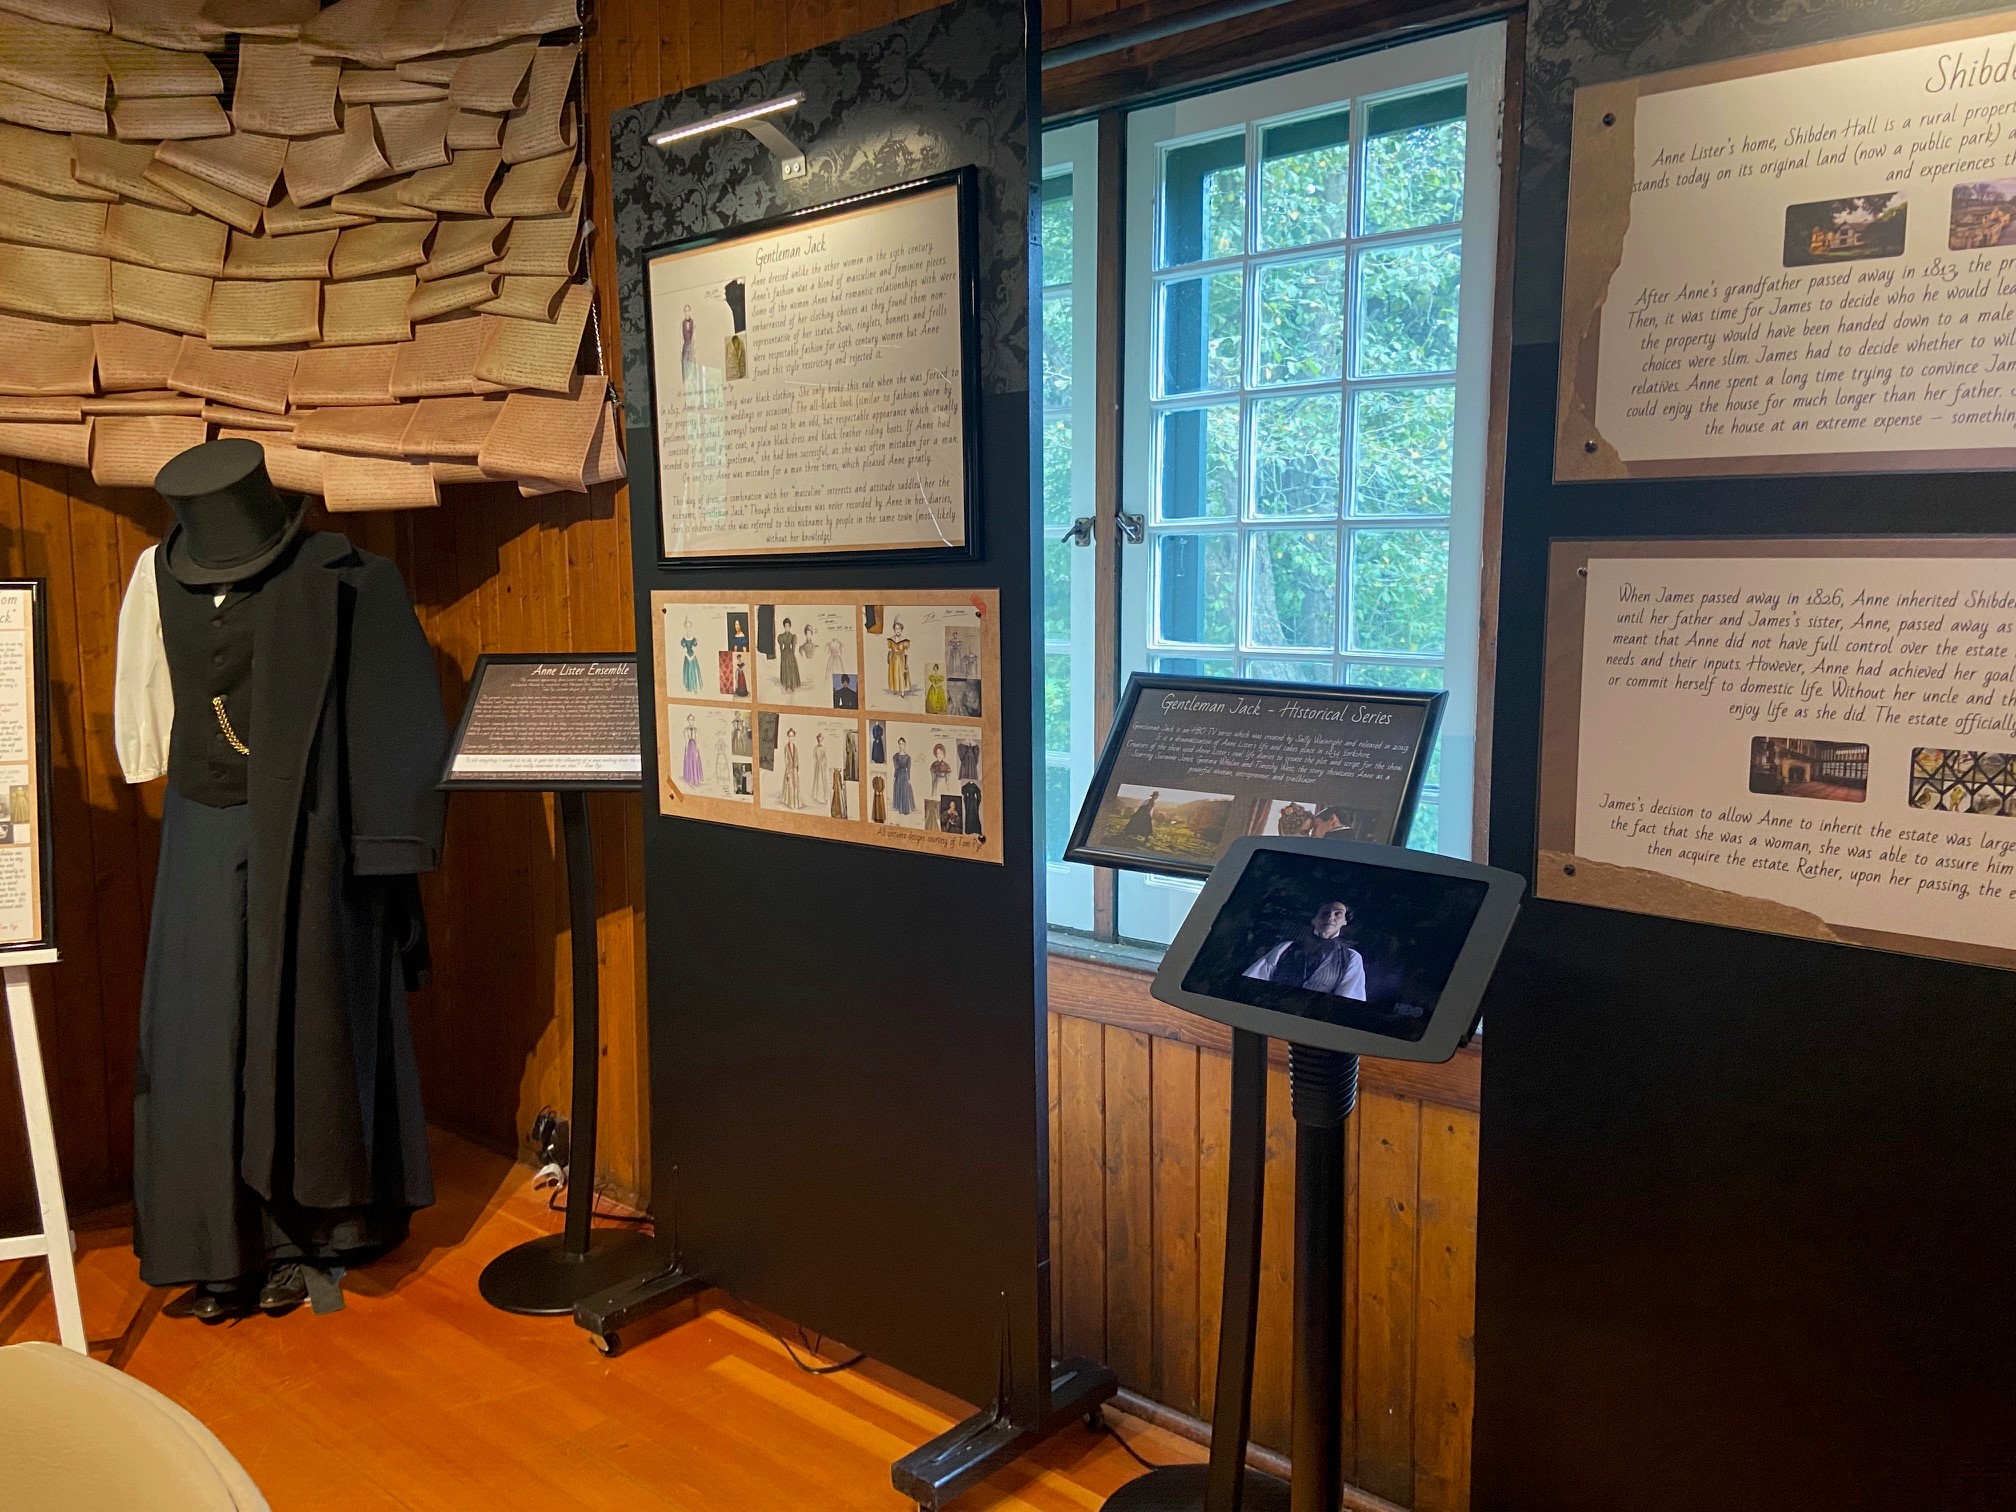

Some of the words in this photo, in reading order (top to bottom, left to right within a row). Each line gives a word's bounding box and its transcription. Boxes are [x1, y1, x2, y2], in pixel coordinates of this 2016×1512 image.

[1651, 148, 1685, 167] Anne
[1690, 137, 1735, 161] Lister's
[1741, 134, 1777, 154] home,
[1784, 123, 1837, 147] Shibden
[1841, 114, 1878, 138] Hall
[1884, 118, 1895, 132] is
[1902, 118, 1911, 129] a
[1919, 102, 1958, 127] rural
[1632, 167, 1671, 195] stands
[1676, 166, 1711, 190] today
[1716, 169, 1731, 181] on
[1738, 164, 1753, 177] its
[1760, 149, 1811, 179] original
[1816, 144, 1848, 166] land
[1854, 141, 1887, 166] (now
[1893, 144, 1903, 155] a
[1908, 130, 1953, 161] public
[1958, 122, 2001, 154] park)
[1885, 159, 1915, 181] and
[1920, 157, 1996, 183] experiences
[751, 275, 765, 287] Anne
[769, 267, 789, 284] dressed
[792, 266, 808, 278] unlike
[812, 262, 821, 275] the
[824, 260, 839, 272] other
[843, 257, 863, 267] women
[877, 248, 886, 260] the
[755, 243, 800, 272] Gentleman
[804, 233, 826, 255] Jack
[752, 287, 770, 301] Anne's
[771, 285, 793, 302] fashion
[797, 284, 807, 292] was
[818, 275, 833, 288] blend
[837, 274, 844, 289] of
[846, 268, 876, 283] masculine
[880, 262, 891, 276] and
[892, 262, 923, 278] feminine
[1634, 288, 1671, 314] After
[1674, 280, 1718, 302] Anne's
[1723, 273, 1802, 303] grandfather
[1807, 266, 1853, 295] passed
[1858, 269, 1895, 288] away
[1902, 265, 1915, 279] in
[1921, 257, 1959, 282] 1813,
[1968, 253, 1992, 273] the
[1705, 418, 1724, 435] the
[1730, 416, 1765, 434] house
[1770, 419, 1786, 432] at
[1791, 420, 1809, 431] an
[1816, 417, 1867, 430] extreme
[1873, 415, 1923, 434] expense
[766, 532, 787, 542] without
[790, 531, 798, 541] her
[1619, 582, 1651, 603] When
[1655, 586, 1695, 603] James
[1700, 587, 1742, 612] passed
[1746, 592, 1781, 611] away
[1787, 592, 1800, 605] in
[1805, 588, 1844, 609] 1826,
[1850, 588, 1890, 607] Anne
[1896, 589, 1960, 608] inherited
[1617, 608, 1645, 624] until
[1650, 608, 1670, 624] her
[1668, 604, 1714, 631] father
[1719, 609, 1745, 626] and
[1748, 610, 1800, 628] James's
[1807, 616, 1844, 631] sister,
[1849, 611, 1891, 633] Anne,
[1896, 614, 1945, 637] passed
[1950, 619, 1989, 640] away
[1996, 623, 2014, 633] as
[531, 664, 557, 676] Anne
[559, 664, 585, 676] Lister
[588, 663, 630, 675] Ensemble
[1606, 650, 1635, 666] needs
[1640, 651, 1665, 667] and
[1669, 651, 1698, 668] their
[1703, 657, 1741, 675] inputs.
[1746, 654, 1805, 676] However,
[1811, 656, 1850, 675] Anne
[1856, 658, 1884, 676] had
[1889, 660, 1948, 679] achieved
[1953, 662, 1978, 680] her
[1982, 664, 2016, 688] goal
[1162, 693, 1225, 715] Gentleman
[1230, 698, 1260, 715] Jack
[1279, 701, 1348, 722] Historical
[1352, 706, 1392, 724] Series
[1599, 793, 1645, 813] James's
[1650, 798, 1694, 817] decision
[1700, 808, 1712, 819] to
[1718, 806, 1753, 823] allow
[1756, 809, 1793, 828] Anne
[1800, 818, 1813, 830] to
[1819, 816, 1863, 835] inherit
[1870, 821, 1892, 839] the
[1898, 830, 1939, 844] estate
[1946, 833, 1972, 847] was
[973, 838, 982, 852] Py
[1647, 840, 1672, 857] then
[1678, 850, 1720, 866] acquire
[1726, 849, 1746, 866] the
[1752, 858, 1789, 872] estate.
[1796, 857, 1842, 881] Rather,
[1850, 871, 1881, 887] upon
[1889, 868, 1912, 886] her
[1916, 879, 1970, 900] passing,
[1979, 879, 2002, 898] the
